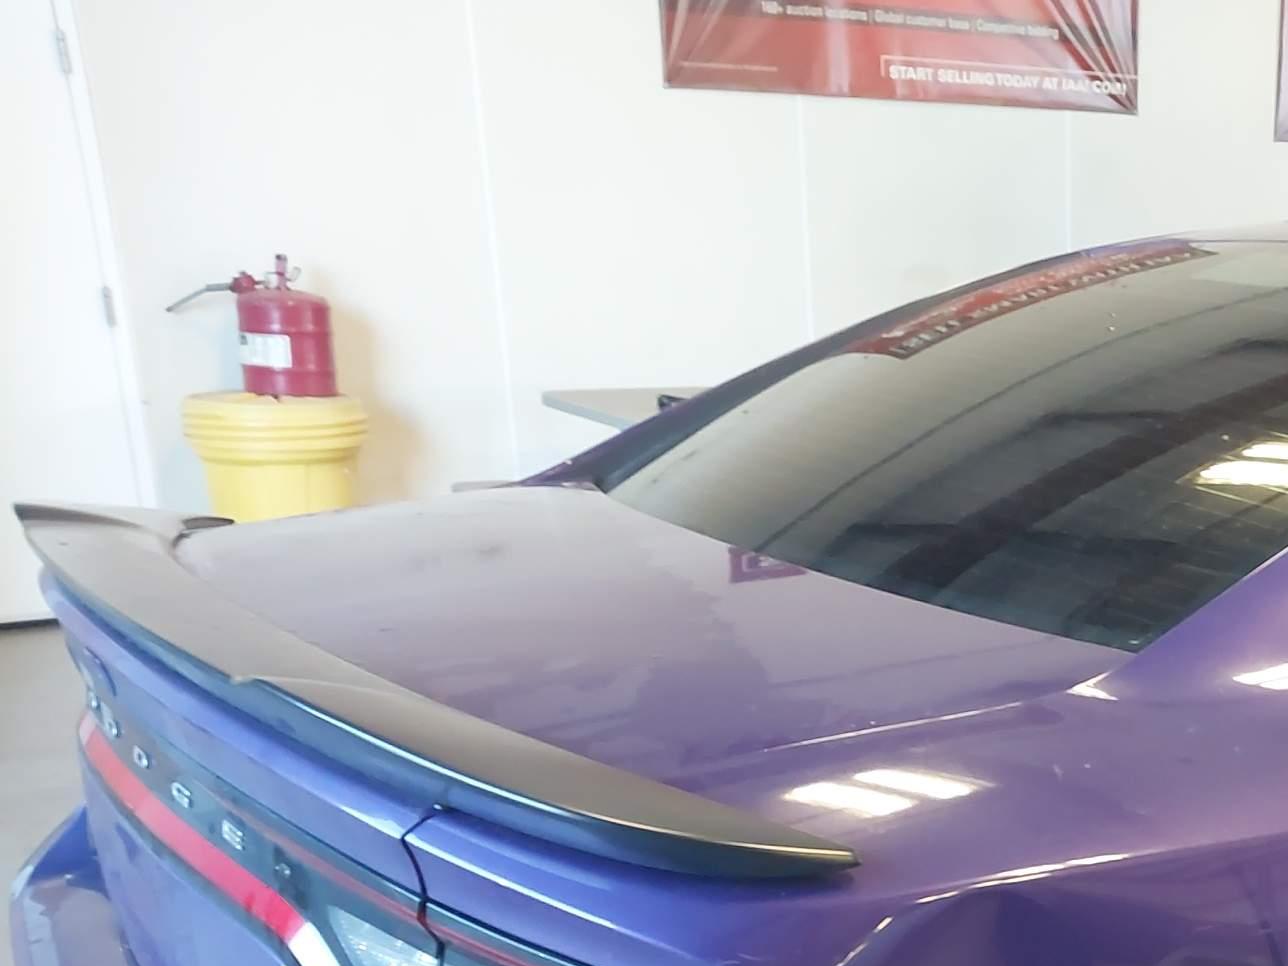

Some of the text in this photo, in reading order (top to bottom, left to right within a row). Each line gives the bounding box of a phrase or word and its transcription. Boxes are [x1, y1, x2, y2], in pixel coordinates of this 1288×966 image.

[889, 65, 934, 80] START
[937, 68, 995, 86] SELLING
[996, 73, 1040, 89] TODAY
[1042, 77, 1058, 90] AT
